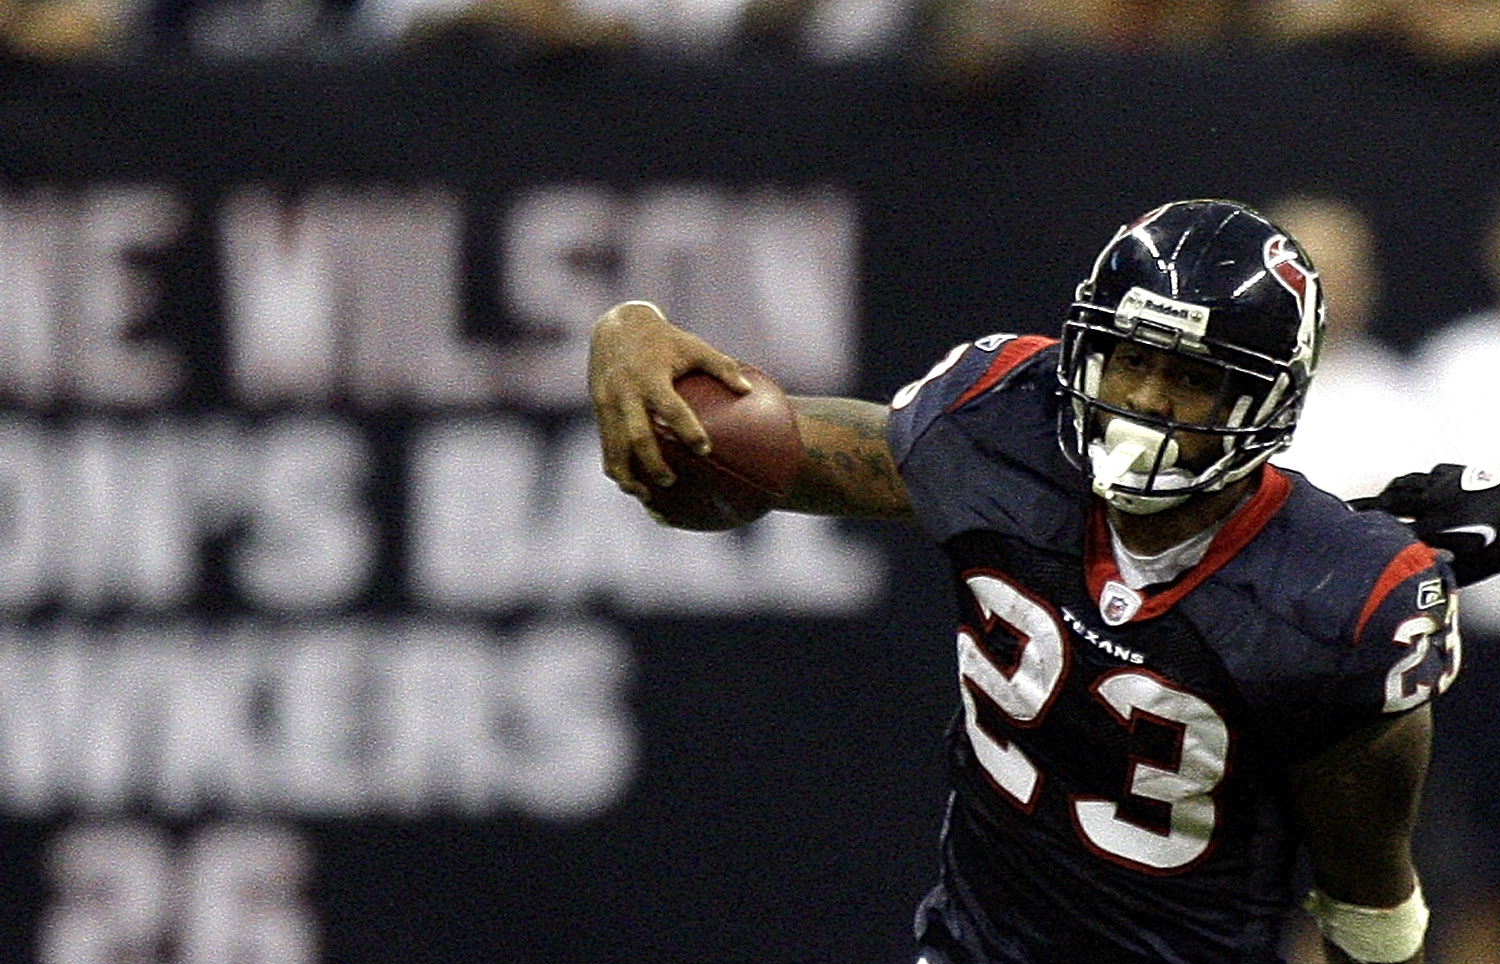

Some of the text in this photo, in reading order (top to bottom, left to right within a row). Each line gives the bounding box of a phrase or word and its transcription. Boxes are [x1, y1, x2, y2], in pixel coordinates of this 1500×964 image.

[220, 184, 858, 402] WILSON
[954, 571, 1231, 873] 23
[1061, 606, 1145, 664] TEXANS
